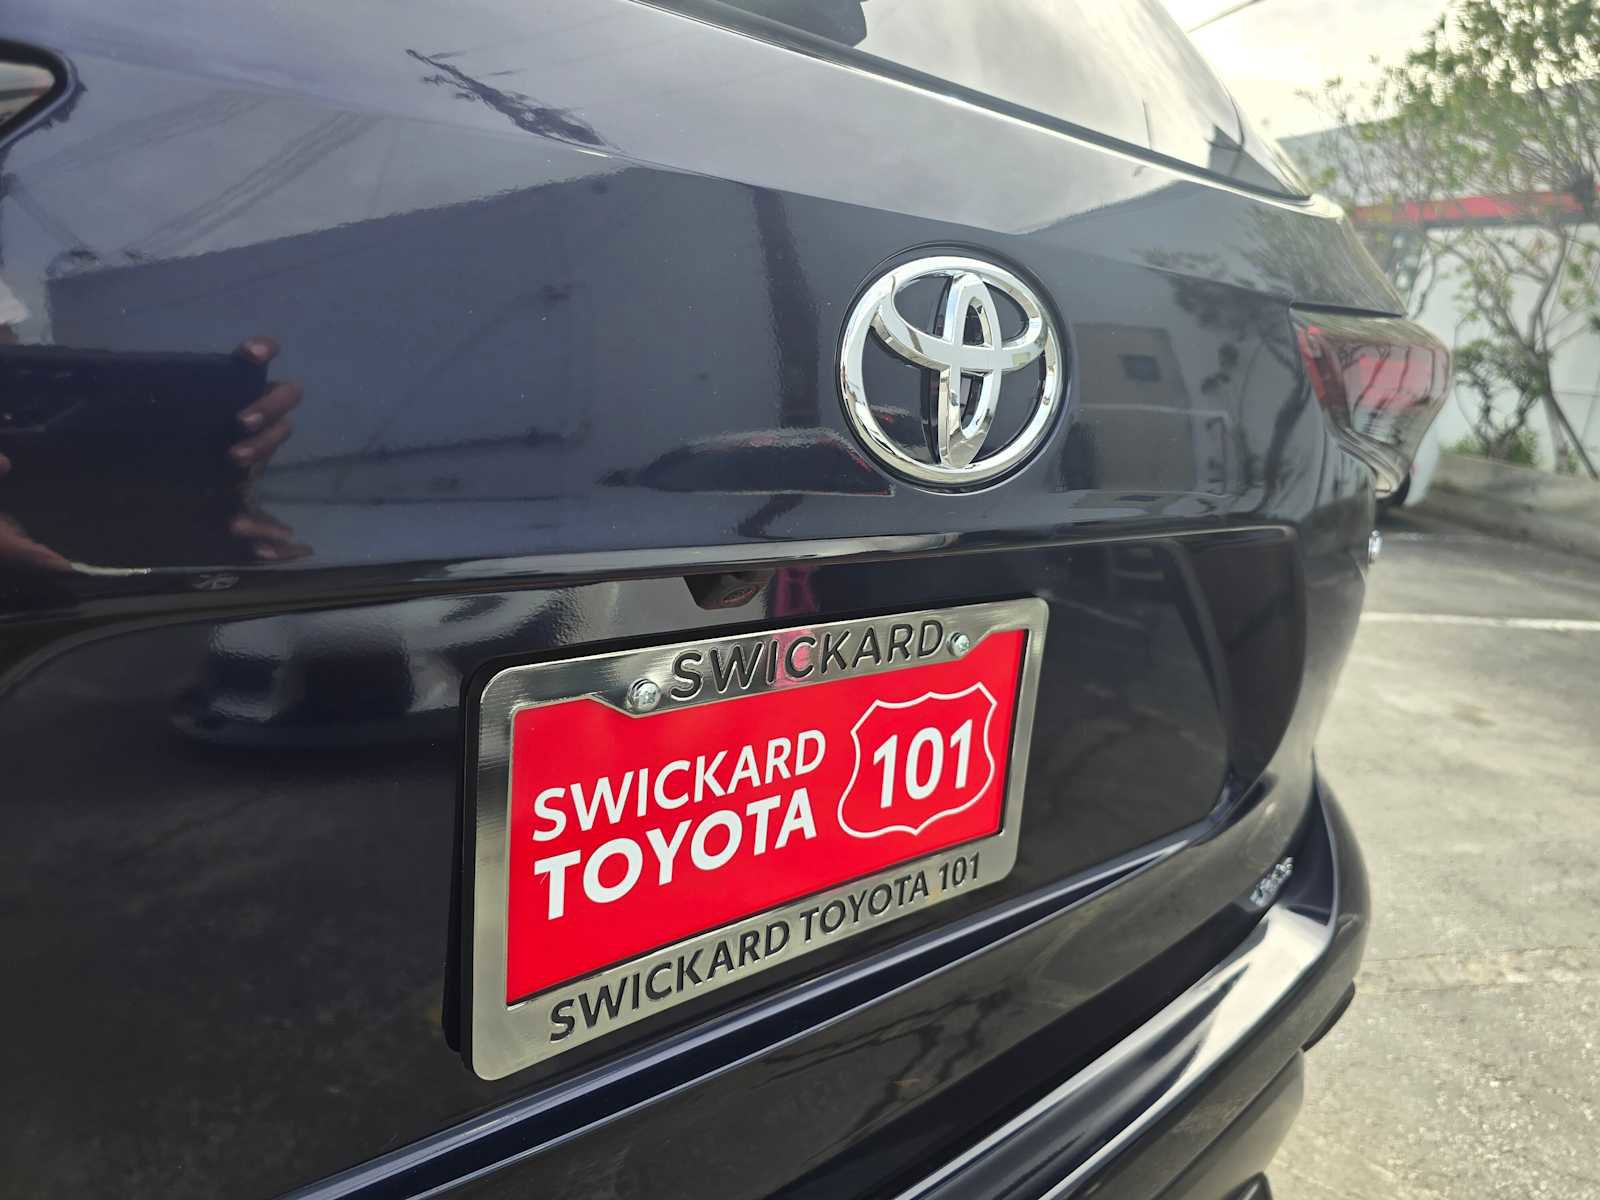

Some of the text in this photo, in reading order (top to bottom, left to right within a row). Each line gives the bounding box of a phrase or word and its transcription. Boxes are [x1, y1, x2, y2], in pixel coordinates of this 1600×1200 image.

[670, 620, 944, 701] SWICKARD
[532, 729, 826, 842] SWICKARD
[872, 720, 974, 809] 101
[534, 788, 817, 920] TOYOTA
[549, 852, 980, 1043] SWICKARD TOYOTA 101
